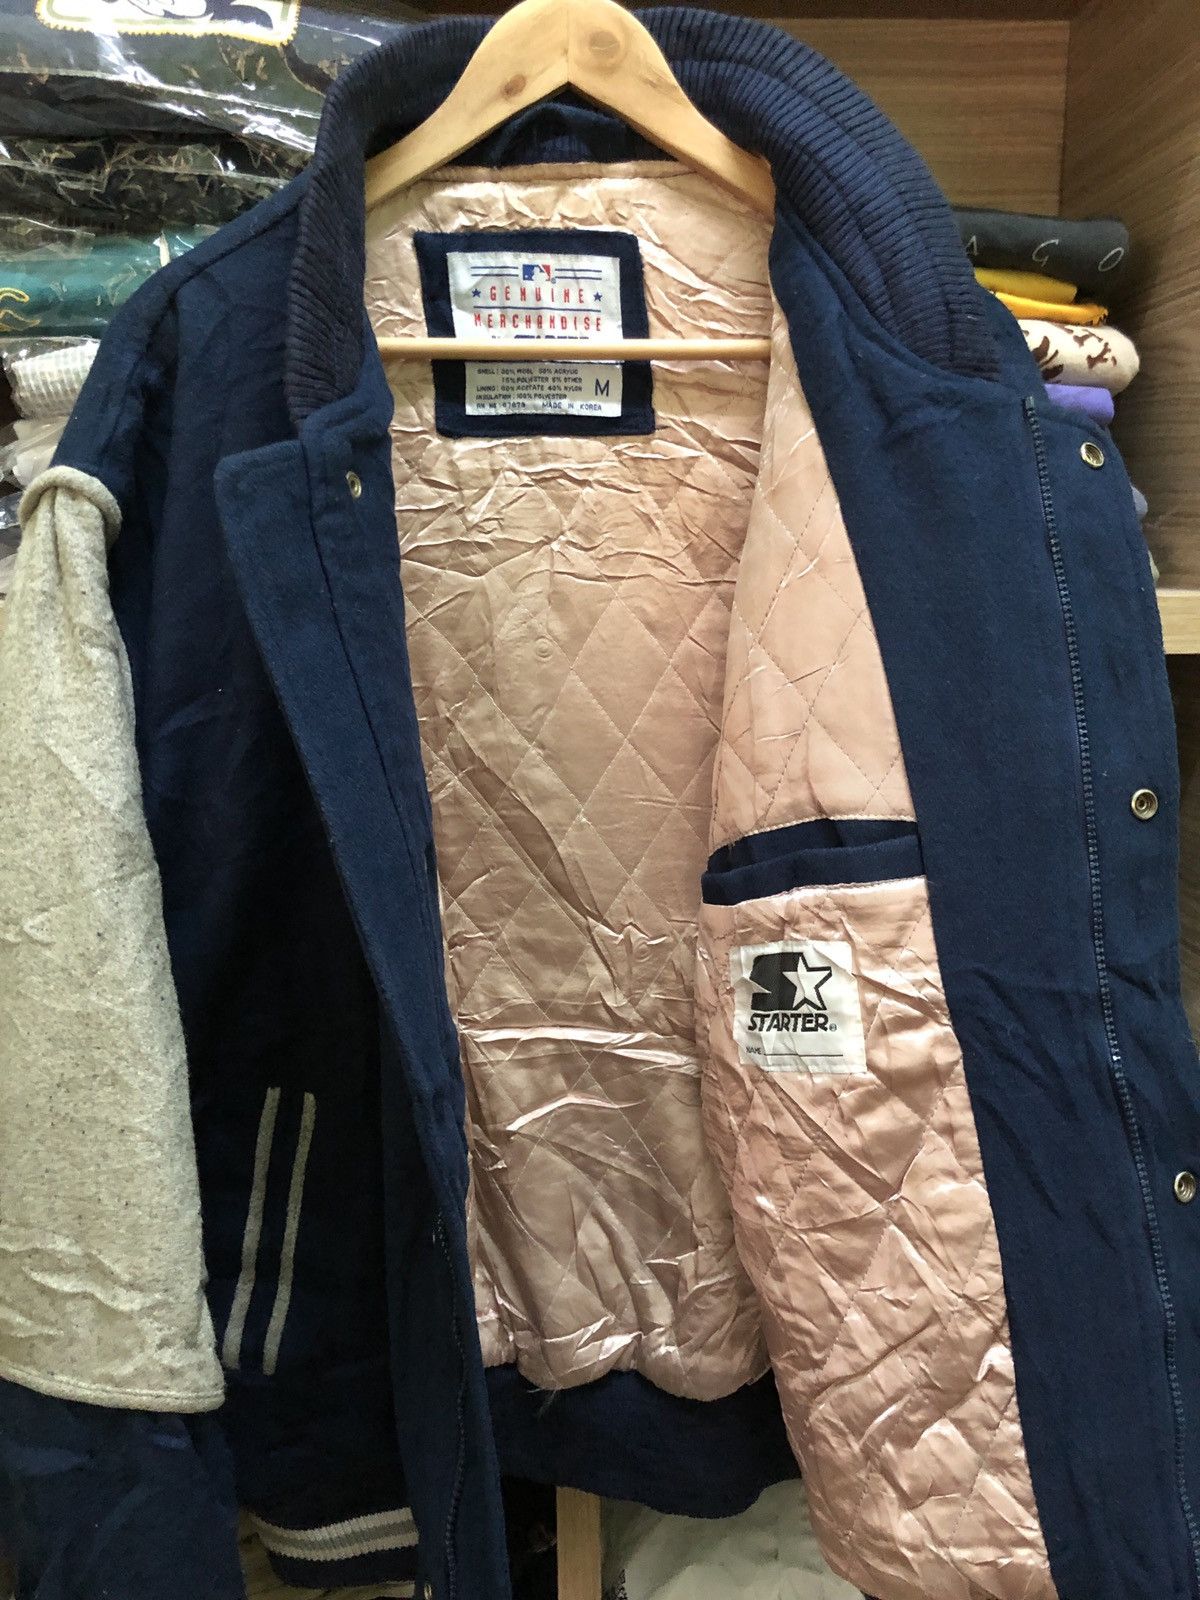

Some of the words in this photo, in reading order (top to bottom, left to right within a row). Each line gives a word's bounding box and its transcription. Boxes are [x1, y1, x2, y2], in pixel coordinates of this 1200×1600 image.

[490, 286, 585, 304] GENUINE
[474, 313, 602, 332] MERCHANDISE
[516, 376, 550, 384] POLYESTER
[595, 378, 610, 397] M
[542, 402, 562, 410] MADE
[580, 403, 602, 411] KOREA
[748, 1012, 829, 1032] STARTER
